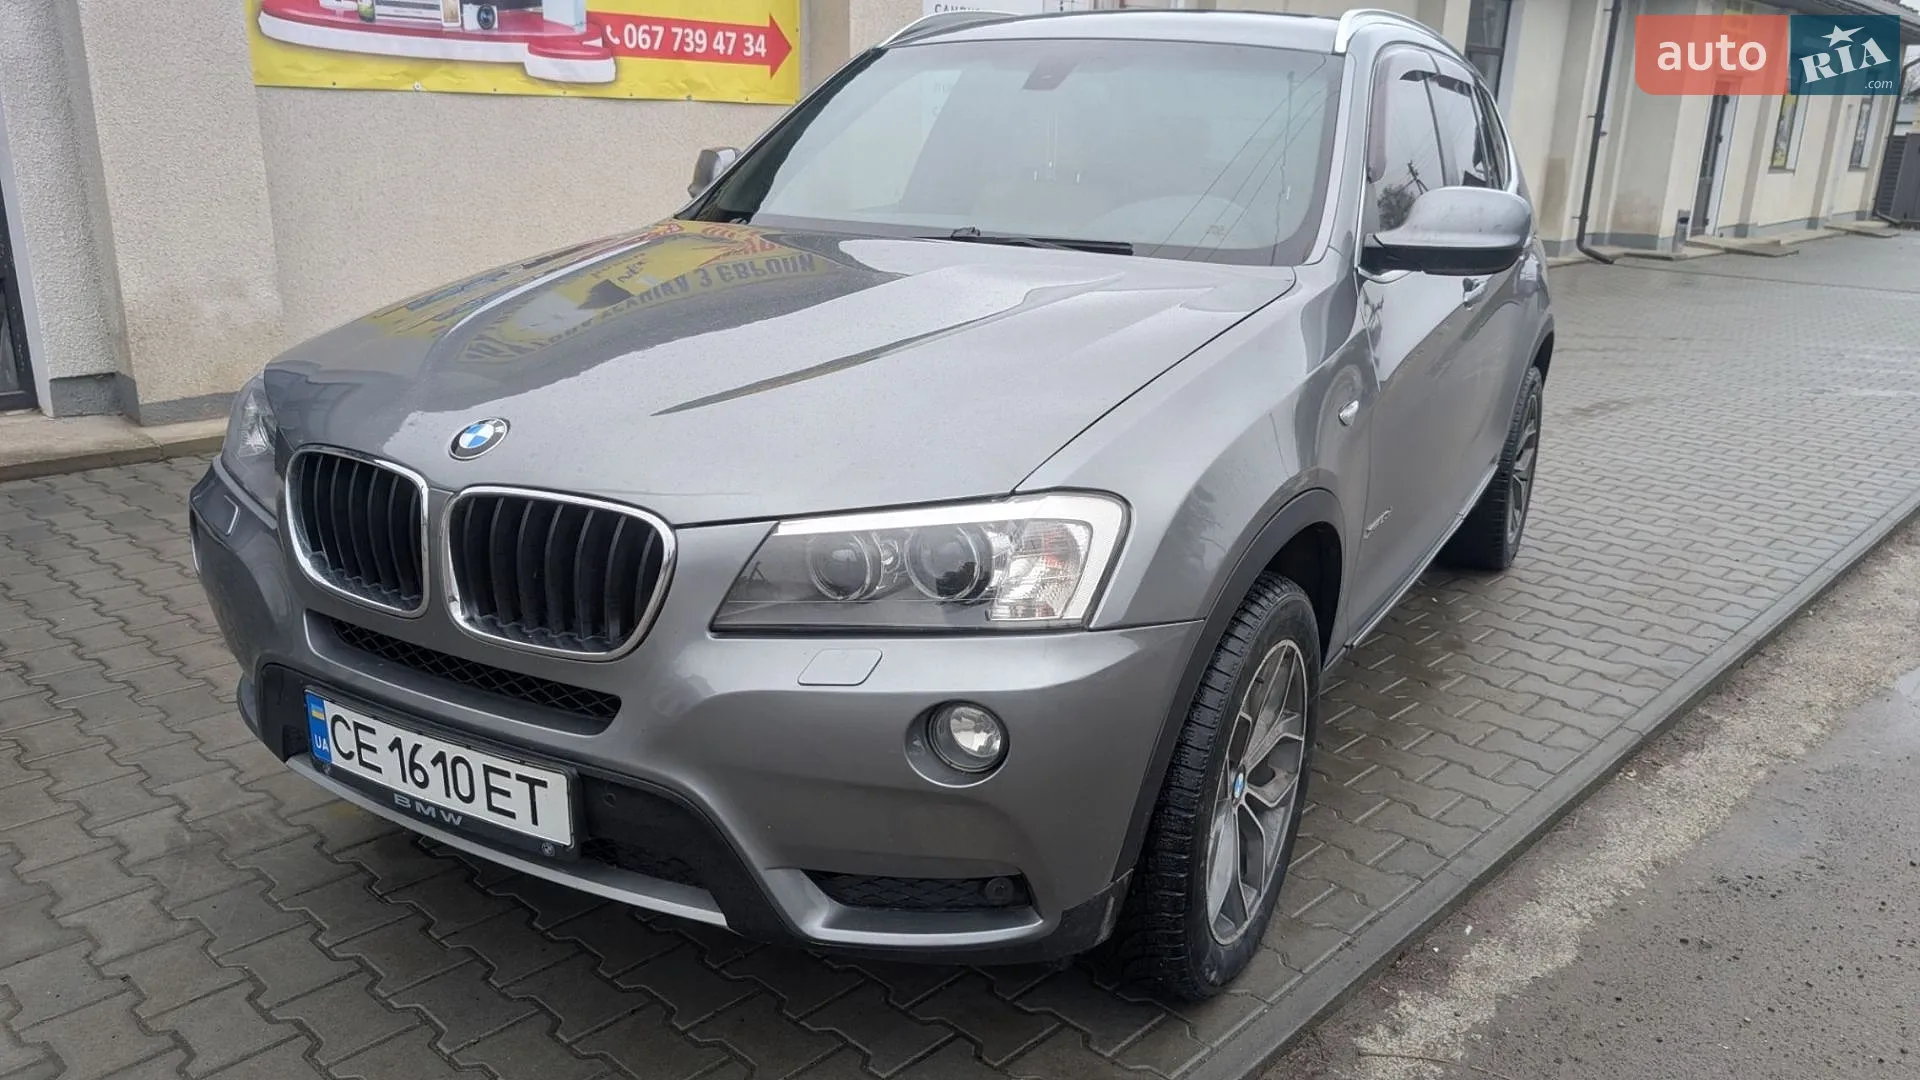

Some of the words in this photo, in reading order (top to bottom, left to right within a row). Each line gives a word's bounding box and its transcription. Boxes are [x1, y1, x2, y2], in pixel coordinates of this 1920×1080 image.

[623, 23, 665, 50] 067
[671, 27, 708, 54] 739
[712, 31, 737, 56] 47
[743, 33, 767, 58] 34
[314, 734, 330, 752] UA
[392, 793, 464, 827] BMW
